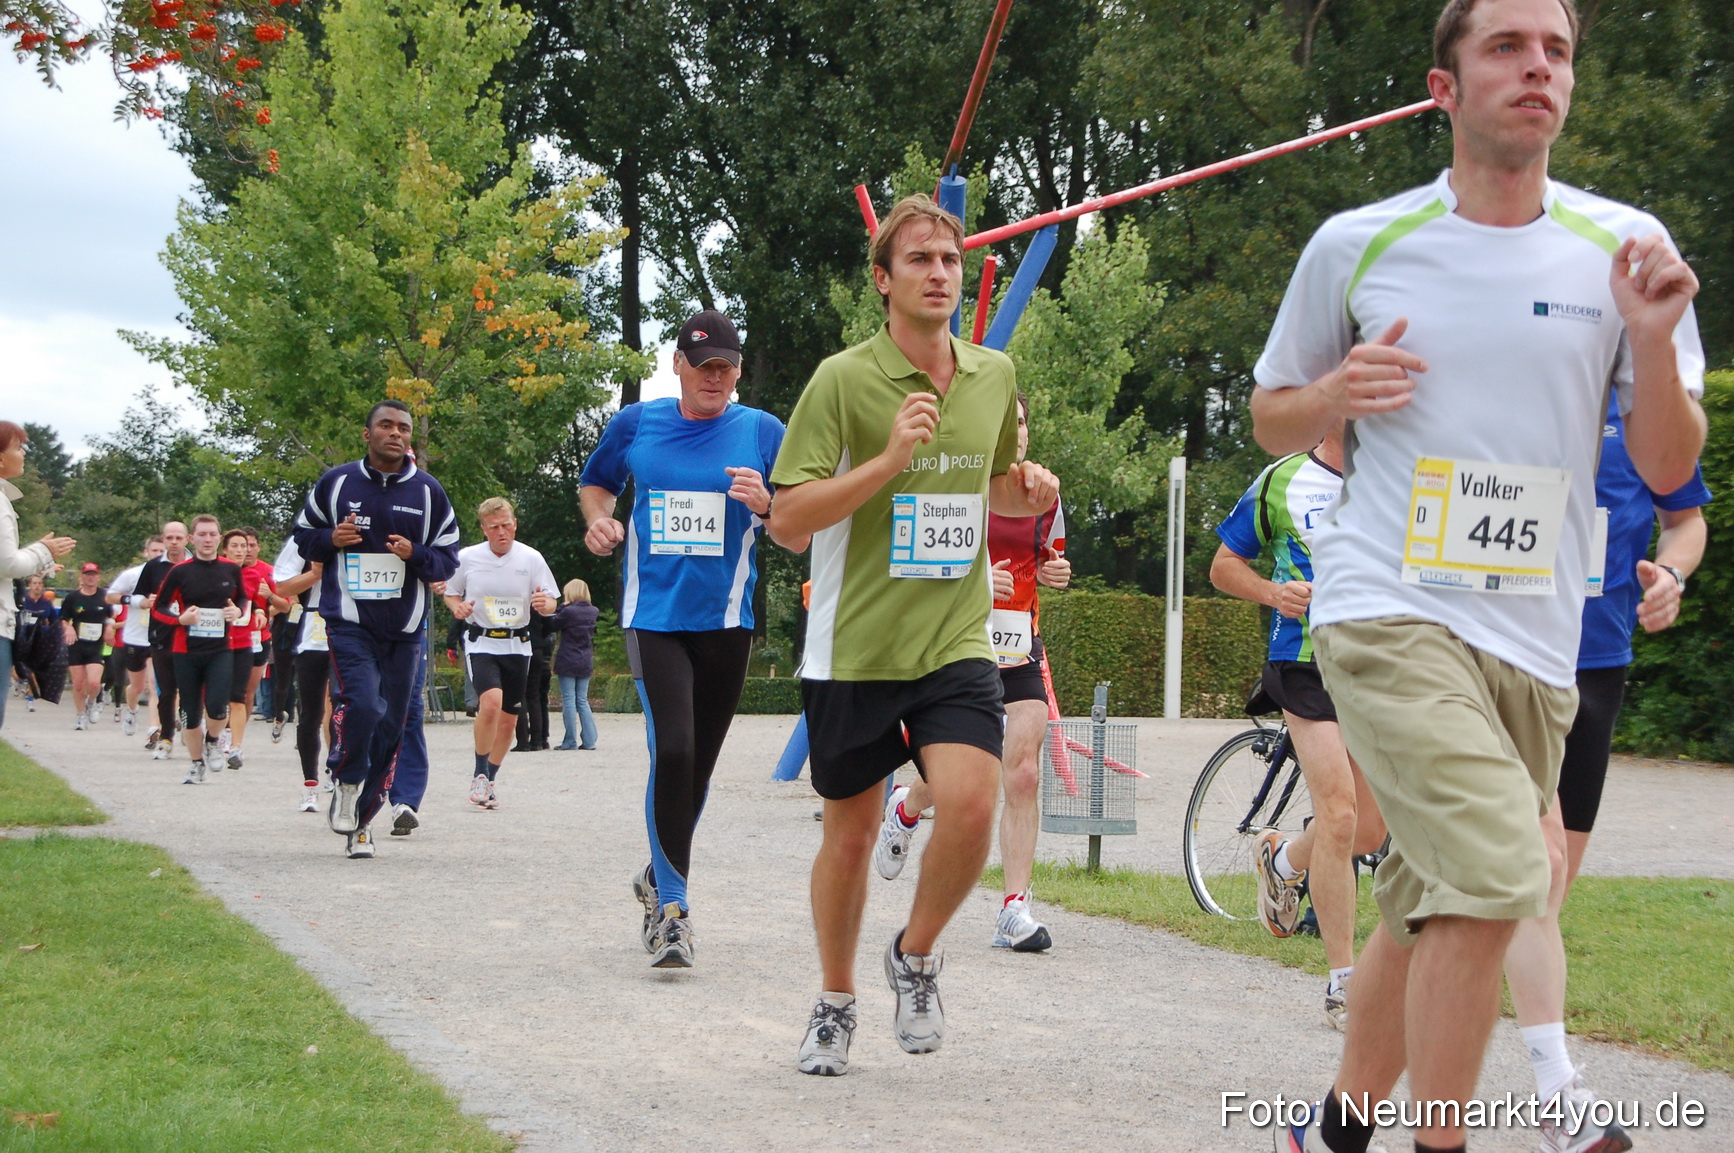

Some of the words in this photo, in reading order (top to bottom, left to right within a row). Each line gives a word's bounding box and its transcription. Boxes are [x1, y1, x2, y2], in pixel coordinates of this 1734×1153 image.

[1550, 303, 1602, 319] PFLEIDERER
[951, 454, 985, 469] POLES
[1461, 472, 1523, 501] Volker
[670, 497, 693, 509] Fredi
[1305, 493, 1338, 503] TEA
[923, 502, 967, 520] Stephan
[1416, 506, 1427, 523] D
[670, 516, 716, 533] 3014
[900, 526, 907, 537] C
[923, 526, 974, 548] 3430
[1468, 515, 1538, 553] 445
[364, 571, 398, 583] 3717
[1501, 574, 1552, 586] PFLEIDERER
[499, 607, 517, 616] 943
[200, 619, 222, 627] 2906
[992, 631, 1022, 648] 977
